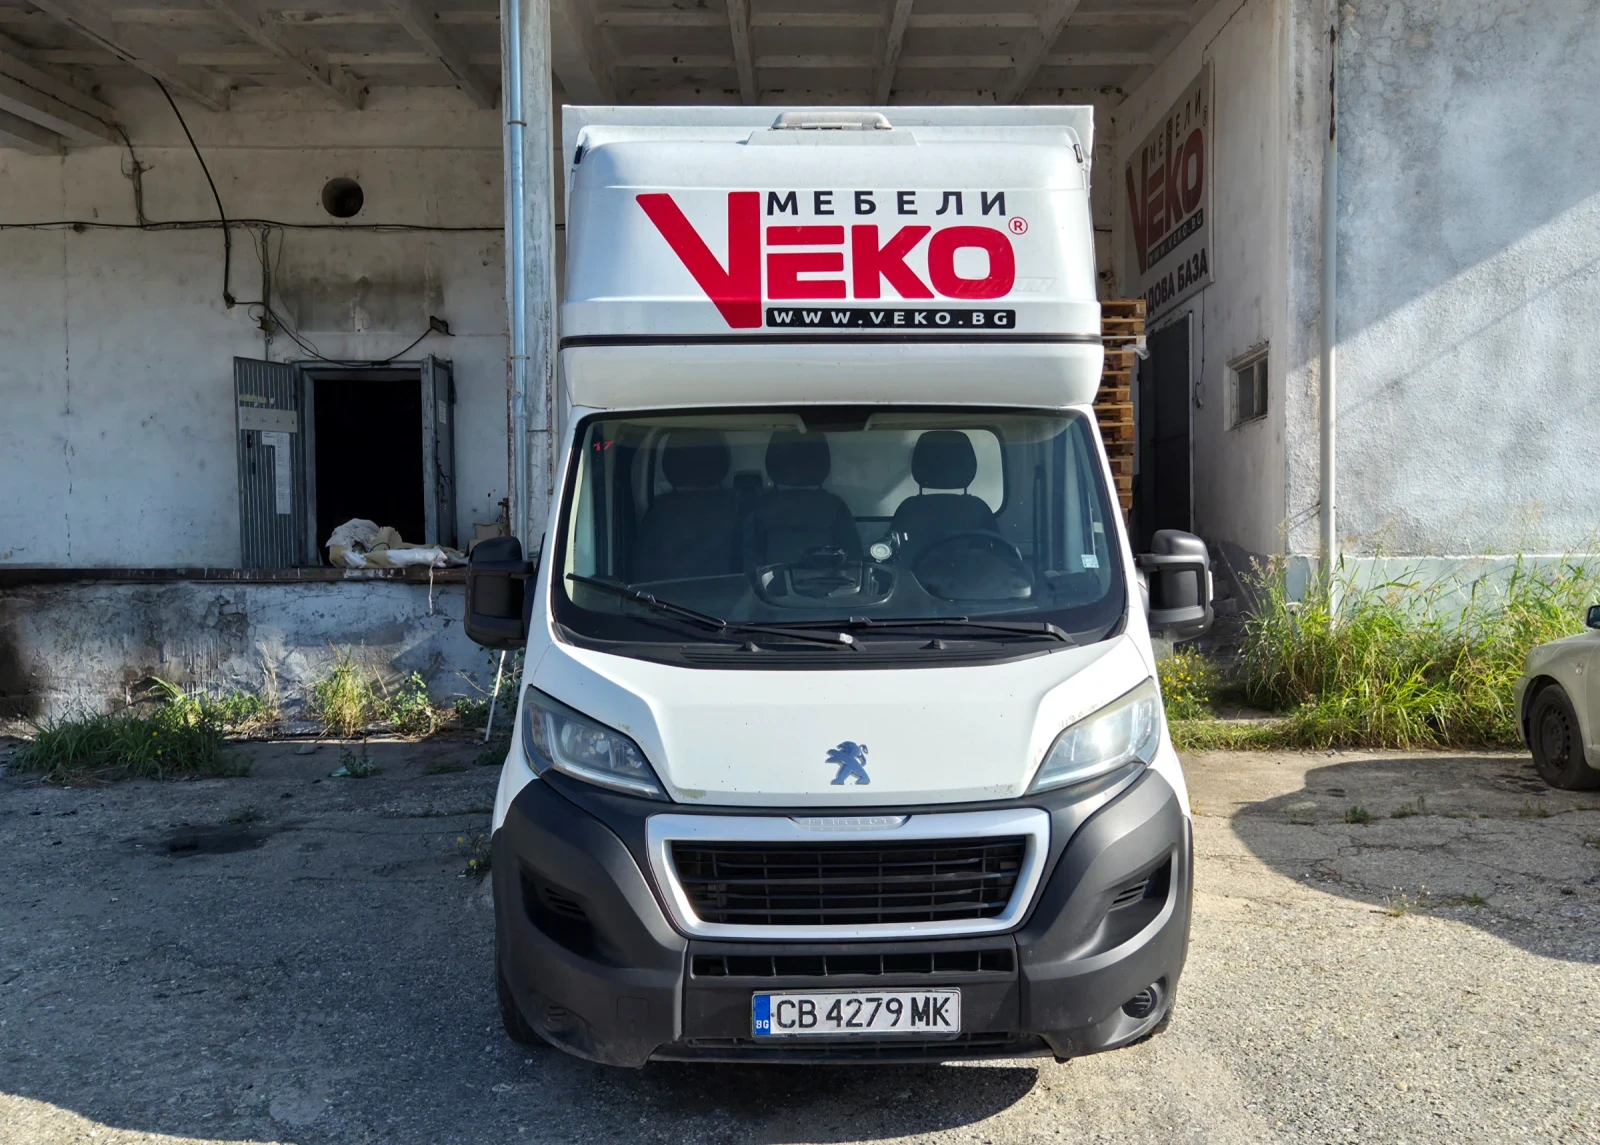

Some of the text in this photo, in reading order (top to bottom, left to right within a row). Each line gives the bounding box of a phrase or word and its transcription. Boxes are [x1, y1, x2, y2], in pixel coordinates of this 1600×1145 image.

[767, 191, 1006, 216] МЕБЕЛИ
[1125, 127, 1204, 276] VEKO
[636, 191, 1016, 329] VEKO
[1177, 247, 1208, 292] БАЗА
[773, 310, 1008, 326] WWW.VEKO.BG
[755, 1020, 769, 1029] BG
[776, 996, 951, 1029] CB 4279 MK
